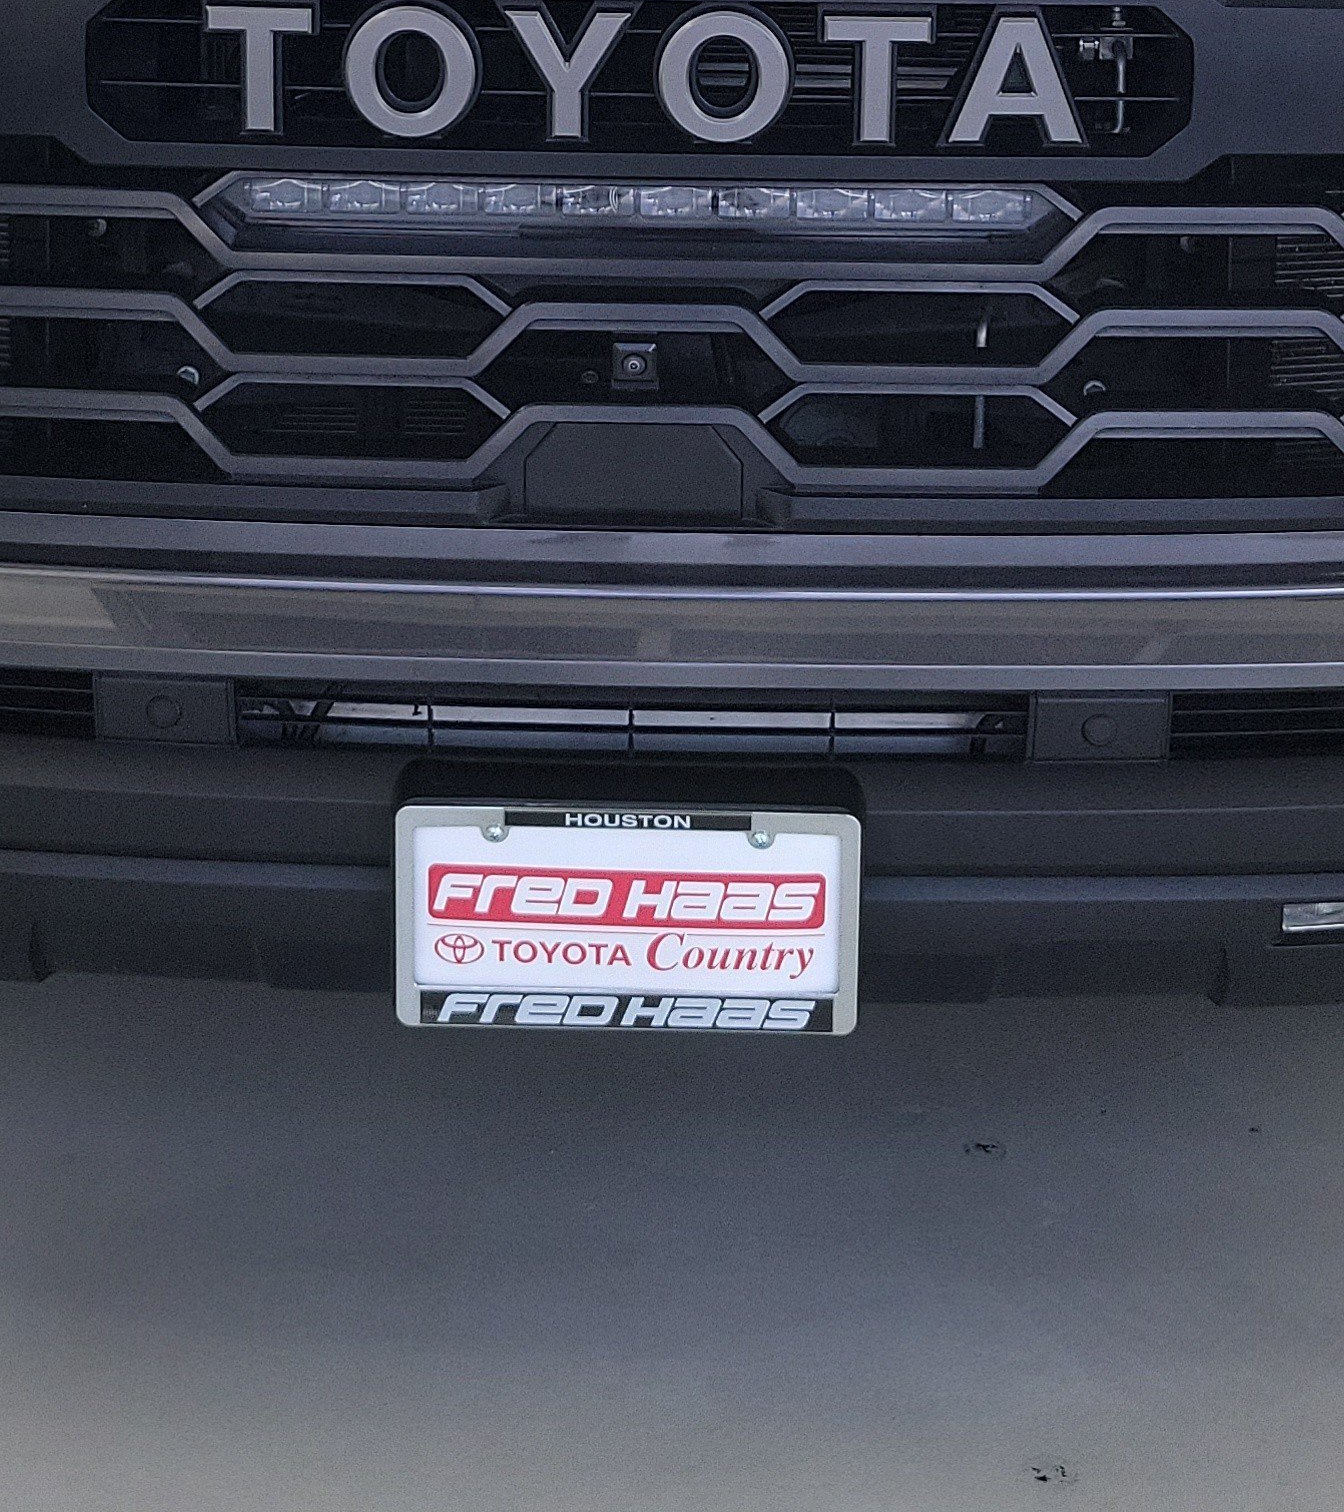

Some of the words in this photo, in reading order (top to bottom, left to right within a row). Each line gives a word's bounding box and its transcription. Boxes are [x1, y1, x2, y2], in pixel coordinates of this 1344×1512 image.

[205, 5, 1082, 144] TOYOTA
[565, 813, 690, 829] HOUSTON
[492, 939, 632, 966] TOYOTA
[647, 933, 814, 980] Country
